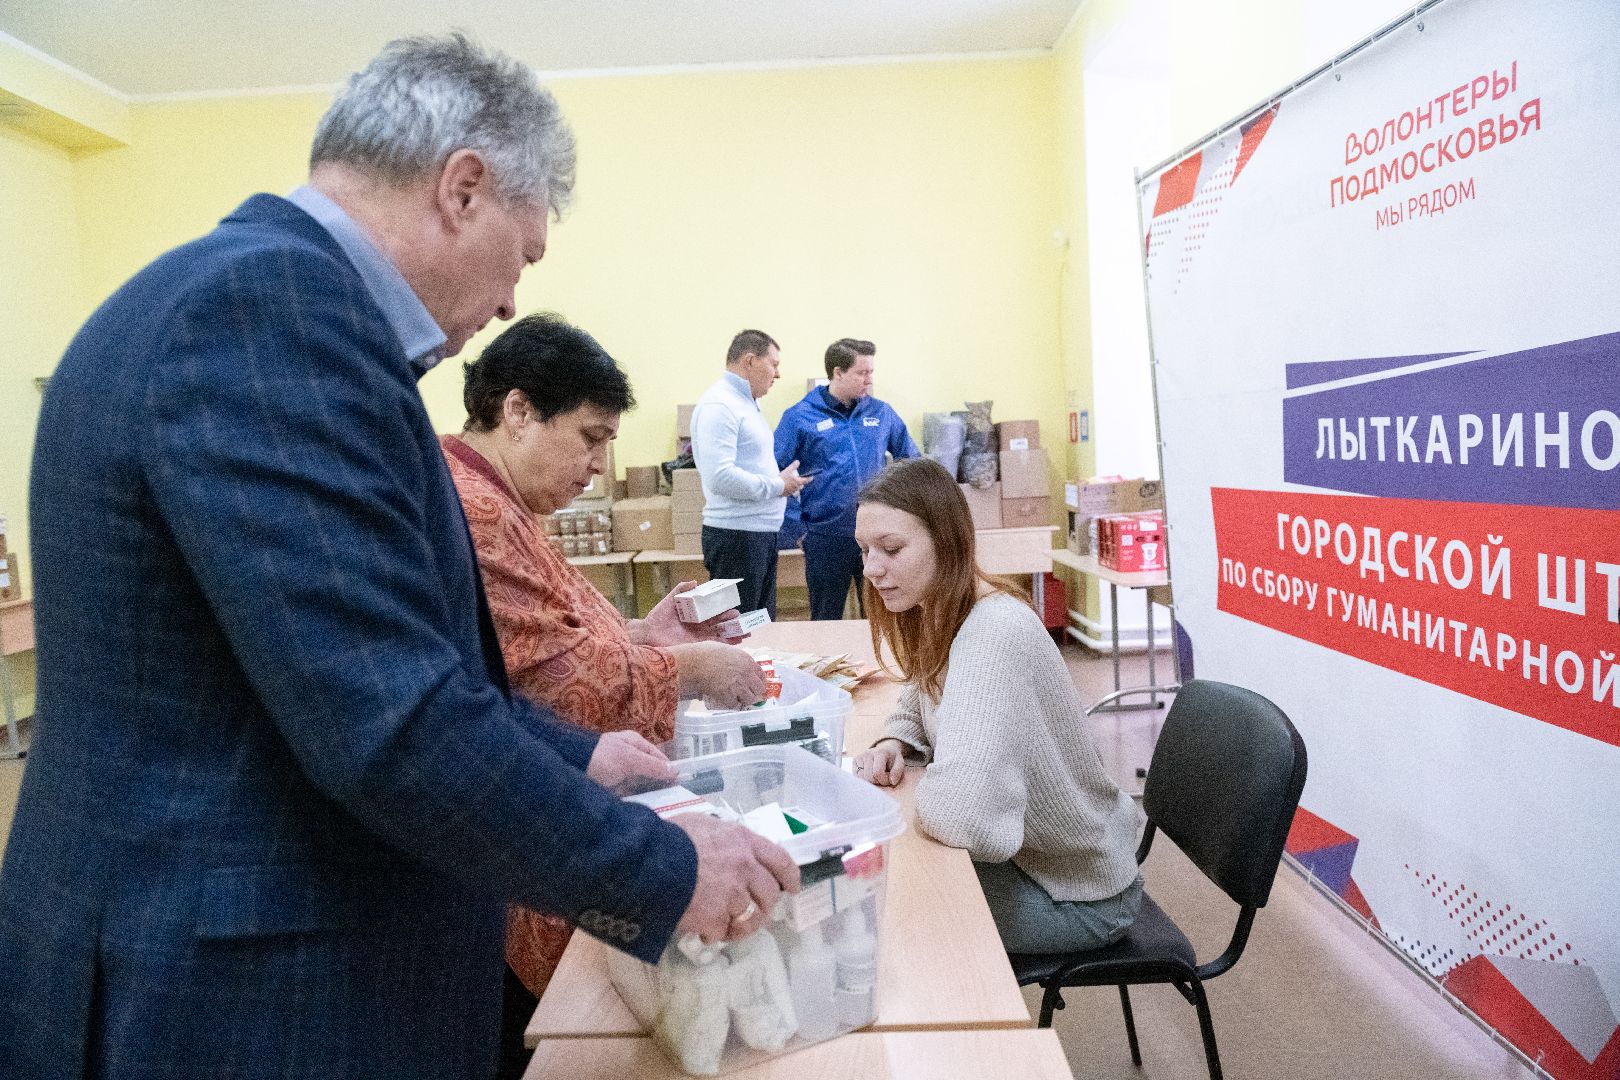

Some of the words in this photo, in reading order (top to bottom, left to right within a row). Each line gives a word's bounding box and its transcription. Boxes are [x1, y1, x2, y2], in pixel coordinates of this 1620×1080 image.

[1330, 98, 1542, 209] ПОДМОСКОВЬЯ
[1344, 60, 1518, 166] ВОЛОНТЕРЫ
[1375, 201, 1404, 231] МЫ
[1407, 178, 1476, 220] РЯДОМ
[1315, 409, 1620, 472] ЛЫТКАРИНО
[1277, 512, 1511, 600] ГОРОДСКОЙ
[1222, 558, 1247, 588] ПО
[1251, 567, 1318, 611] СБОРУ
[1326, 587, 1620, 709] ГУМАНИТАРНОЙ
